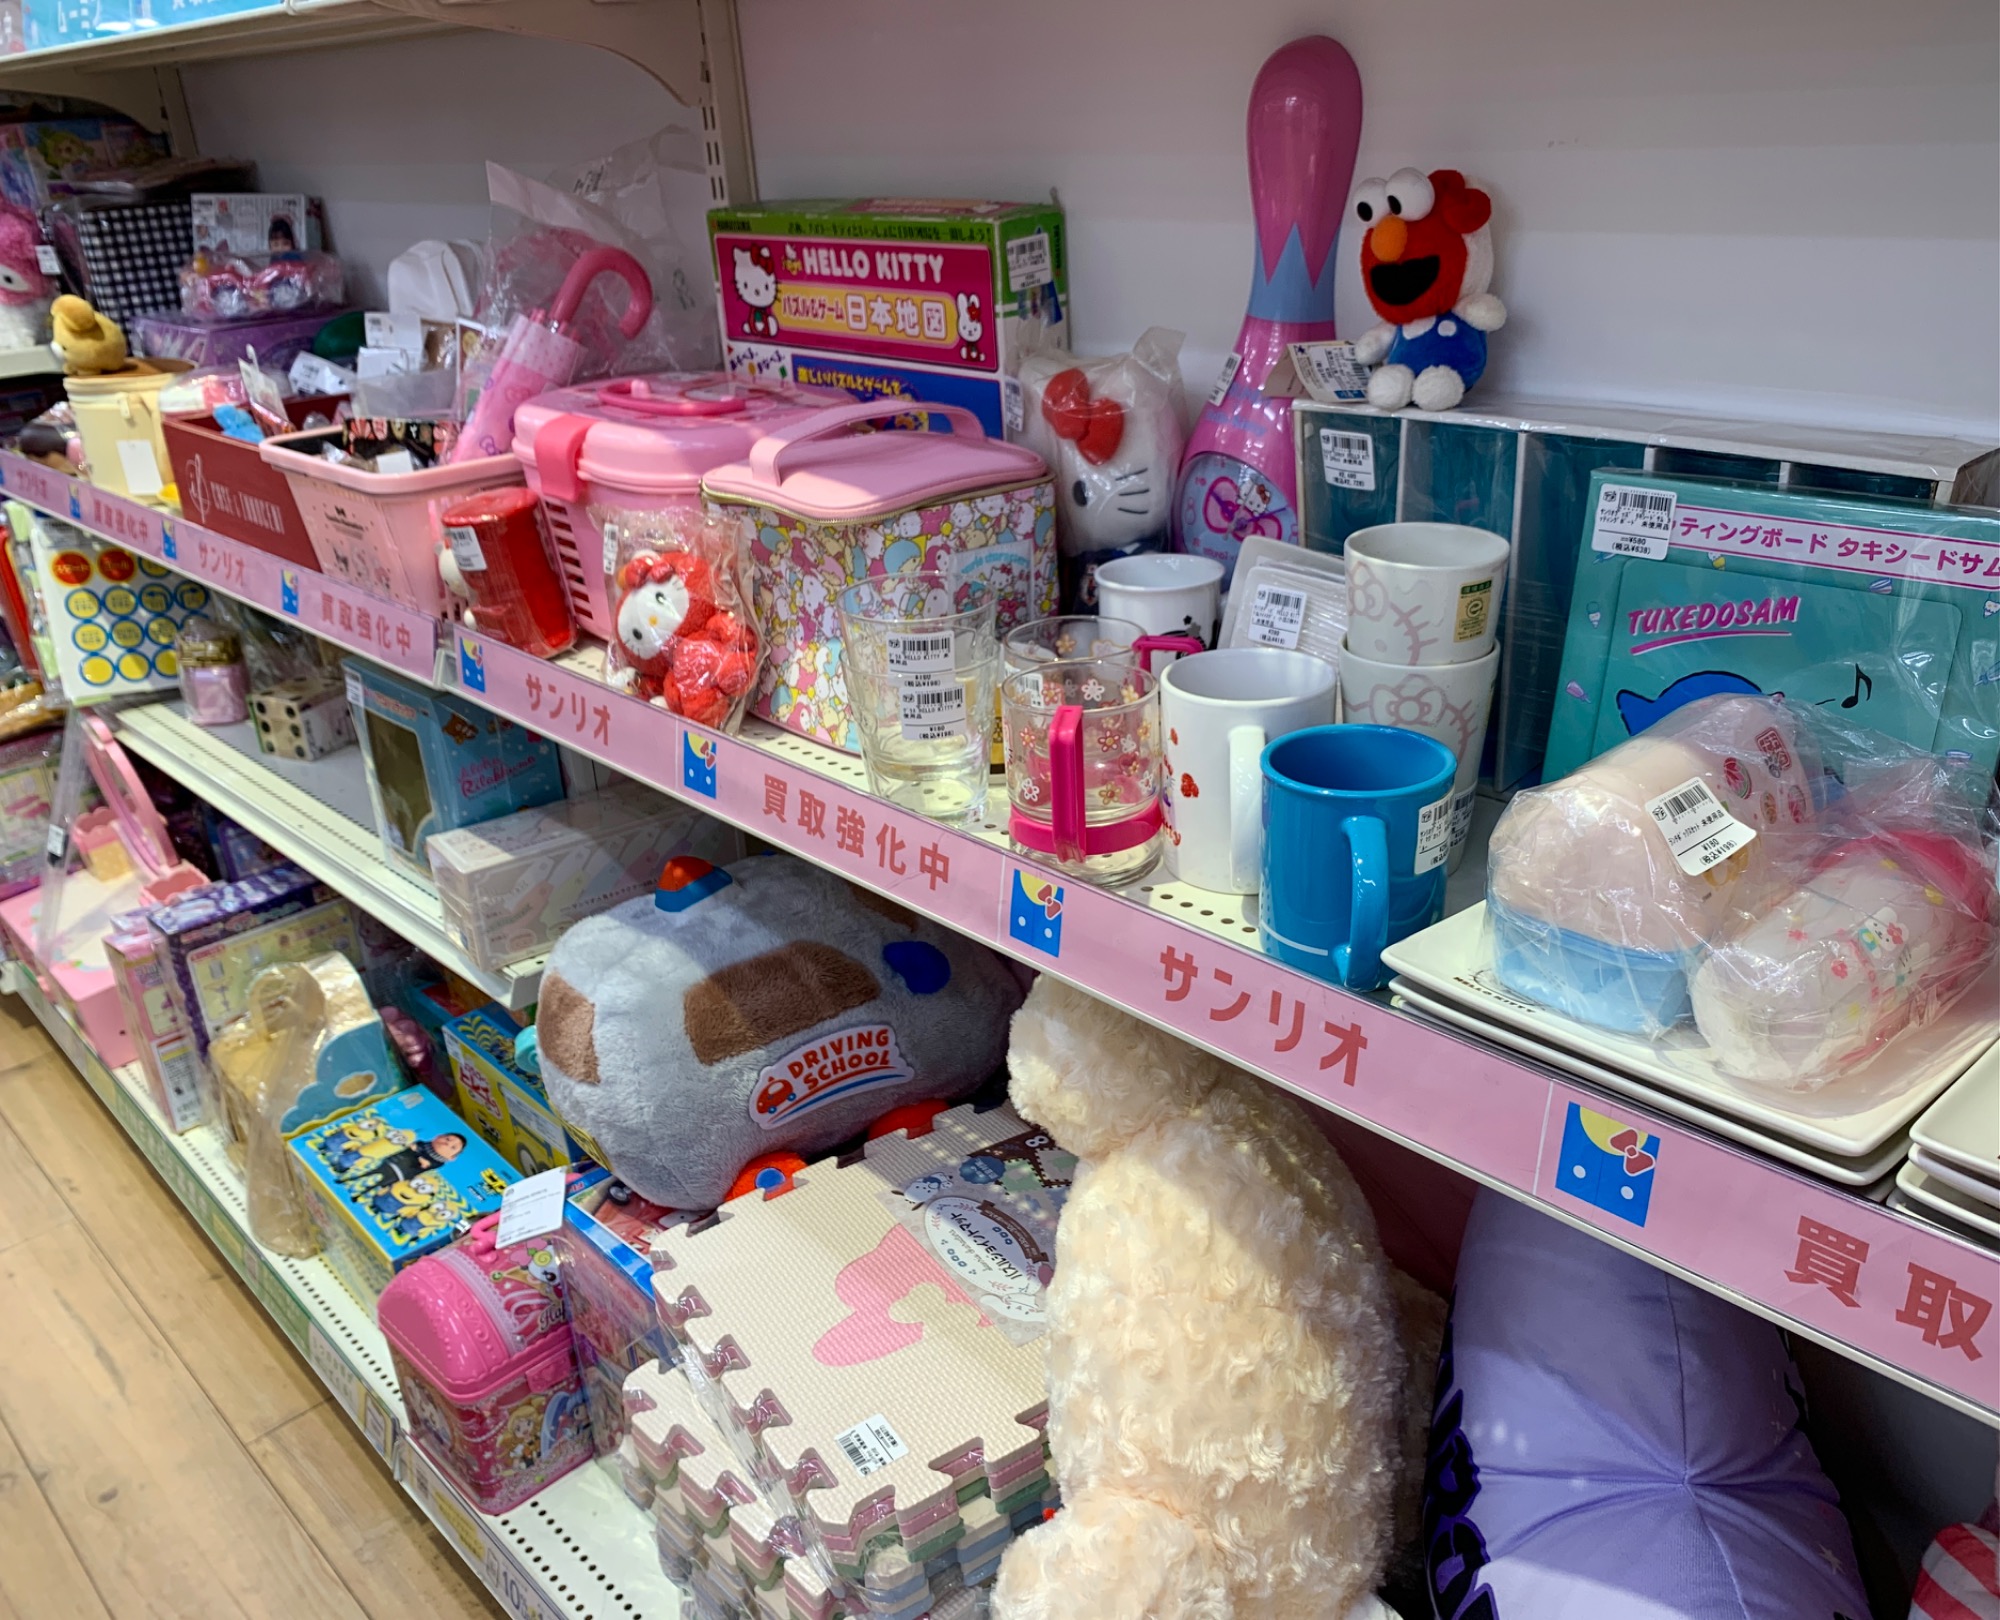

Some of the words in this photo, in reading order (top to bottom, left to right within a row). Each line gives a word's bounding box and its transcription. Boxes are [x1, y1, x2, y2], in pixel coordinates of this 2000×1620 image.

[802, 246, 870, 280] HELLO
[875, 250, 944, 284] KITTY
[846, 293, 947, 340] 日本地図
[199, 542, 247, 587] サンリオ
[1838, 537, 2000, 579] タキシードサム
[321, 591, 412, 657] 買取強化中
[1628, 596, 1800, 636] TUXEDOSAM
[526, 673, 611, 746] サンリオ
[763, 773, 950, 891] 買取強化中
[1701, 809, 1725, 827] 未使用品
[1699, 839, 1738, 866] (税込¥198)
[1701, 838, 1719, 851] ¥180
[1158, 944, 1369, 1088] サンリオ
[788, 1027, 890, 1080] DRIVING
[802, 1049, 891, 1092] SCHOOL
[951, 1212, 1024, 1281] パズルジョイントマット
[1783, 1215, 1993, 1362] 買取
